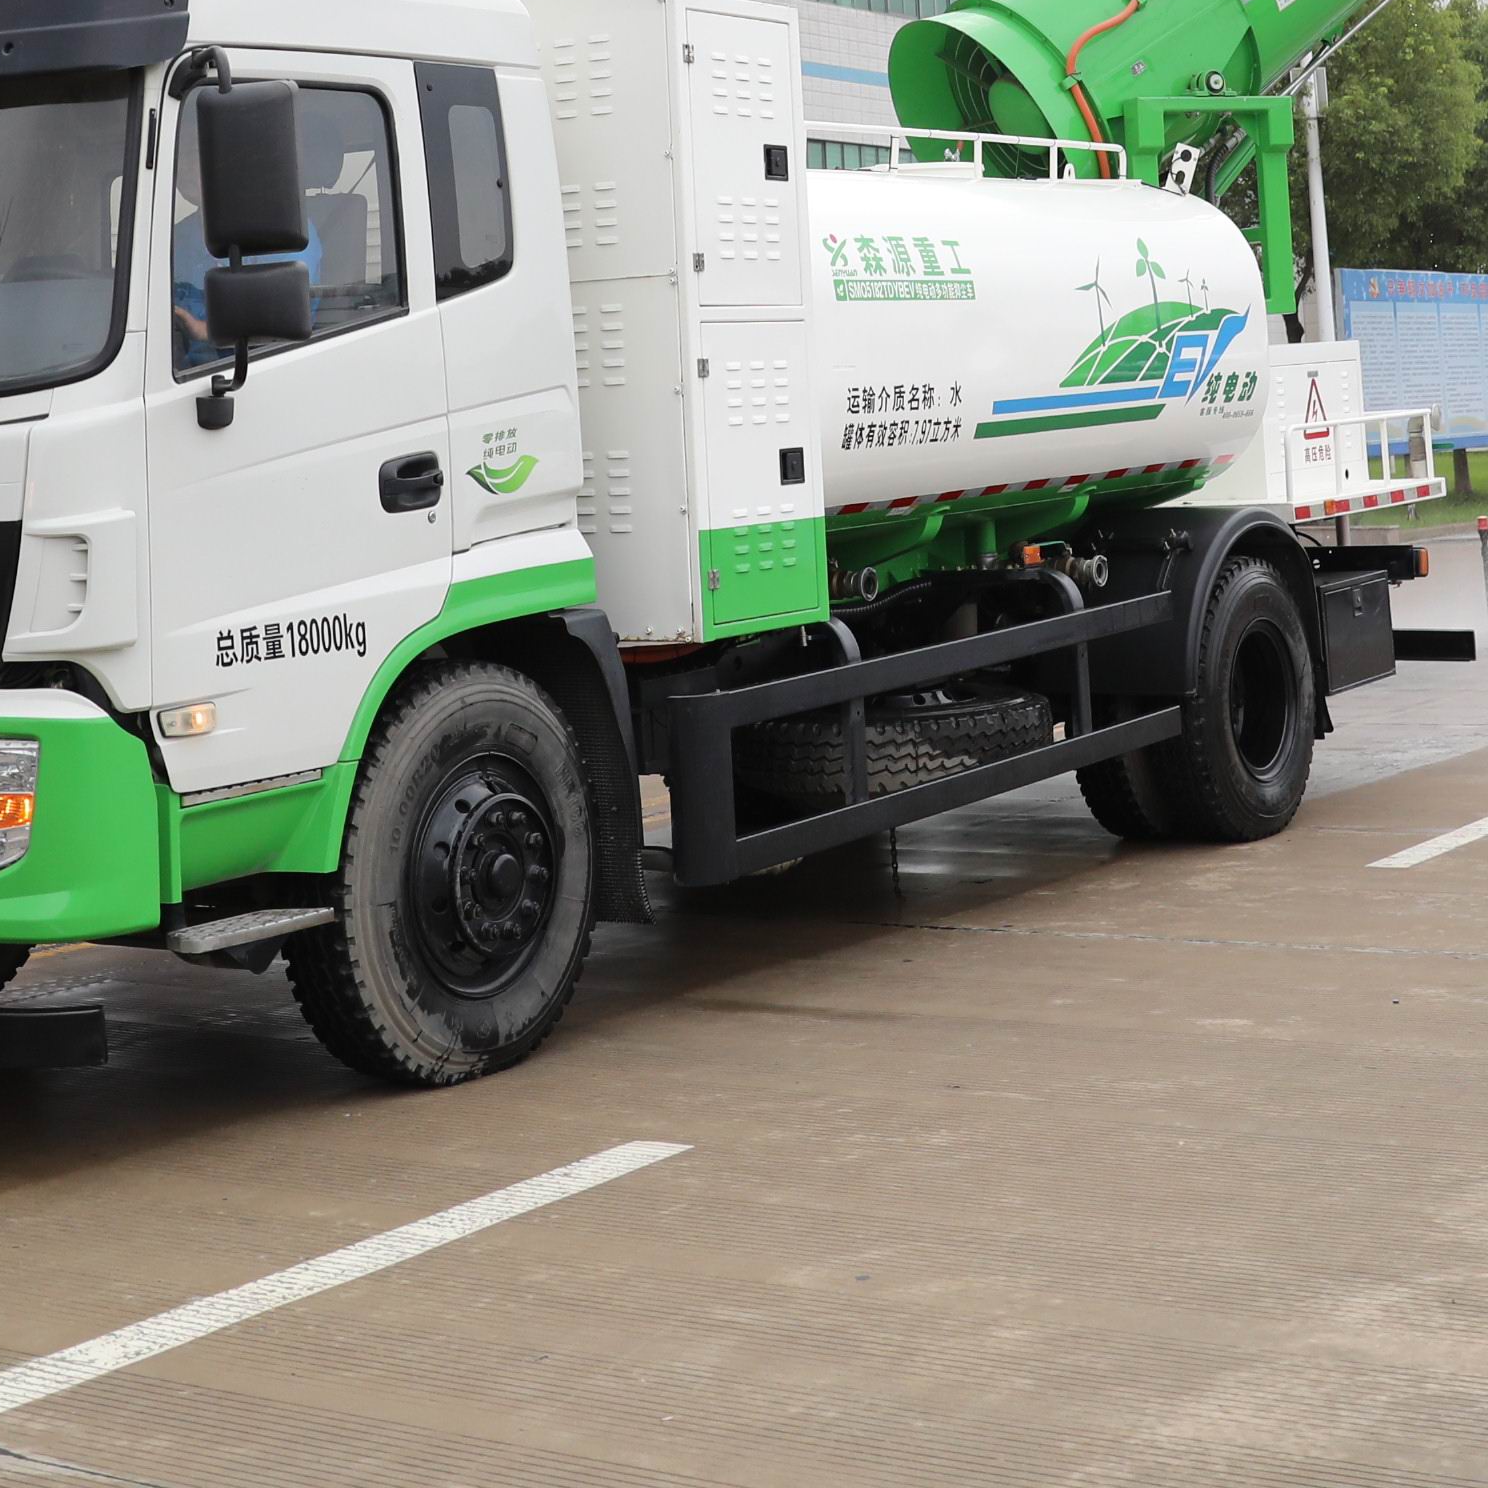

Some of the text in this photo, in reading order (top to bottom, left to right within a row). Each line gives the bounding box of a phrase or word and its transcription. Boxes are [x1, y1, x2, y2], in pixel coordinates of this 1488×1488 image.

[853, 234, 972, 277] 森源重工
[1157, 303, 1251, 408] EV
[1201, 371, 1258, 404] 纯电动
[483, 442, 517, 460] 纯电动
[215, 613, 367, 667] 总质量18000kg
